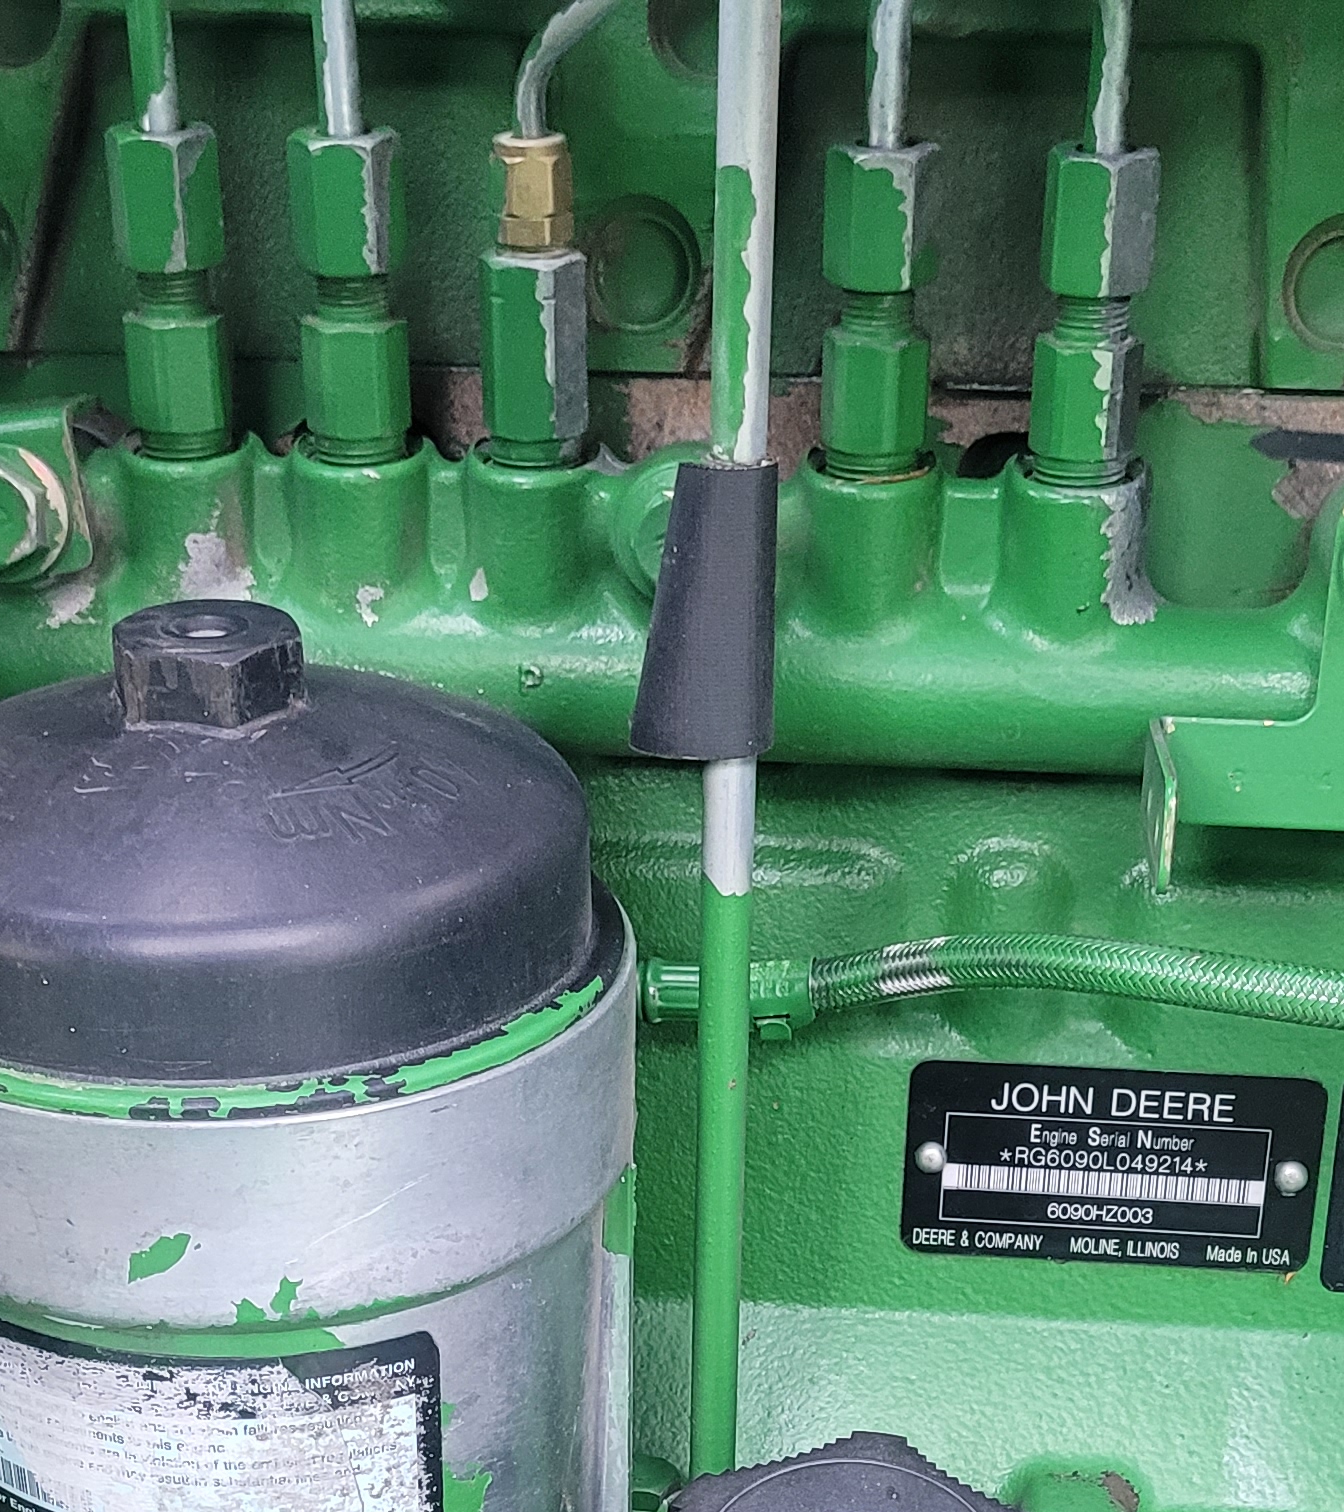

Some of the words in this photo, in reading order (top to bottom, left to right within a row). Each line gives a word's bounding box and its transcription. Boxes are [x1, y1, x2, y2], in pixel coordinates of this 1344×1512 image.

[991, 1082, 1094, 1115] JOHN
[1111, 1088, 1236, 1122] DEERE
[1030, 1123, 1077, 1147] Engine
[1087, 1126, 1130, 1148] Serial
[1137, 1129, 1195, 1151] Number
[1047, 1202, 1153, 1225] 6090HZ003
[912, 1228, 956, 1246] DEERE
[960, 1230, 969, 1247] &
[975, 1231, 1043, 1251] COMPANY
[1070, 1236, 1122, 1257] MOLINE,
[1127, 1240, 1180, 1260] ILLINOIS
[1206, 1245, 1242, 1263] Made
[1262, 1249, 1290, 1266] USA
[305, 1358, 416, 1389] INFORMATION
